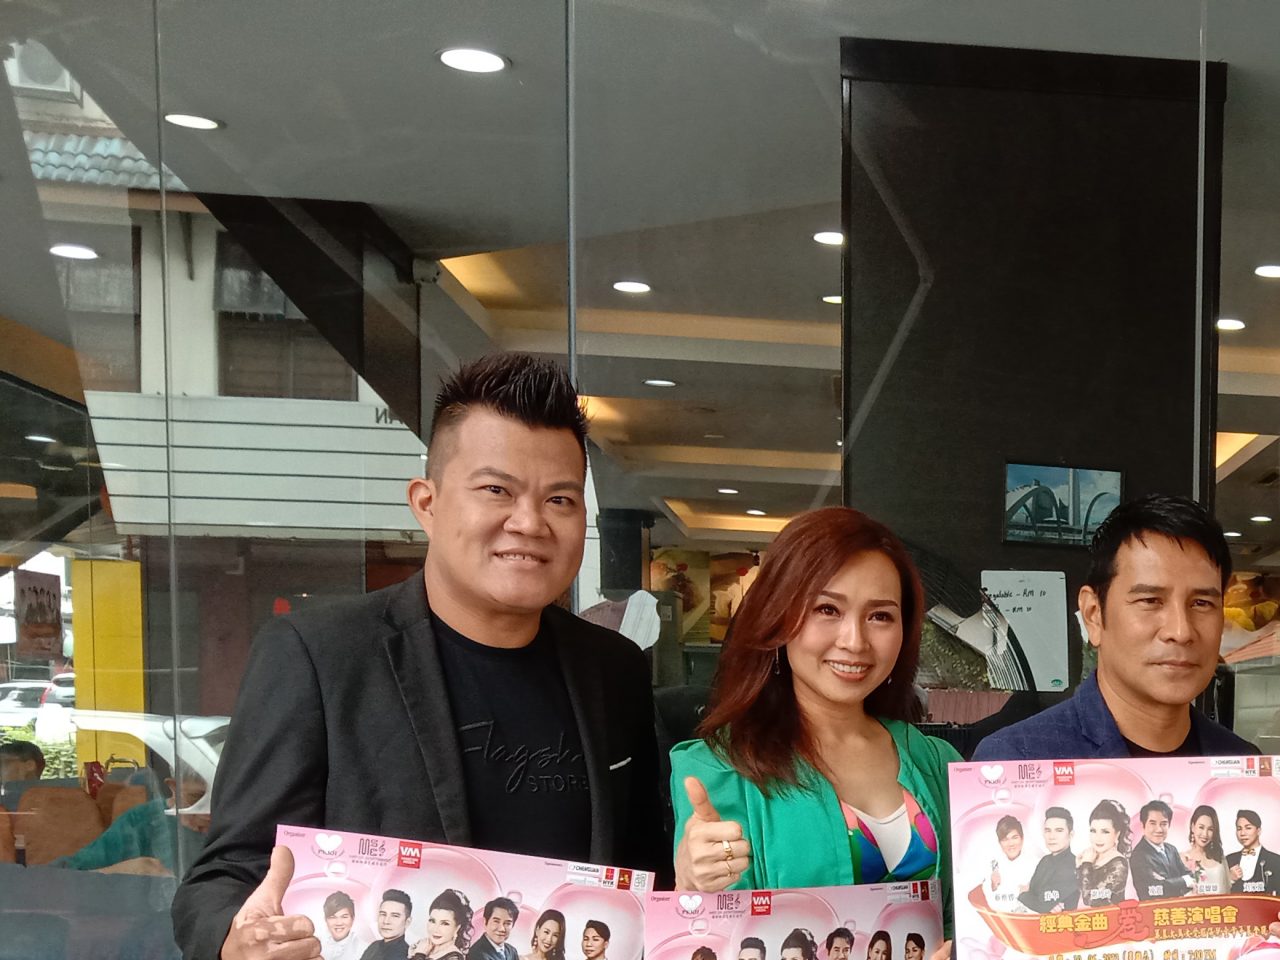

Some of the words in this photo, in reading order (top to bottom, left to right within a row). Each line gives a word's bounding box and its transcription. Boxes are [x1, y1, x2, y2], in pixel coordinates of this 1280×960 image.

[1039, 914, 1108, 933] 經典金曲
[1153, 906, 1238, 926] 慈善演唱會
